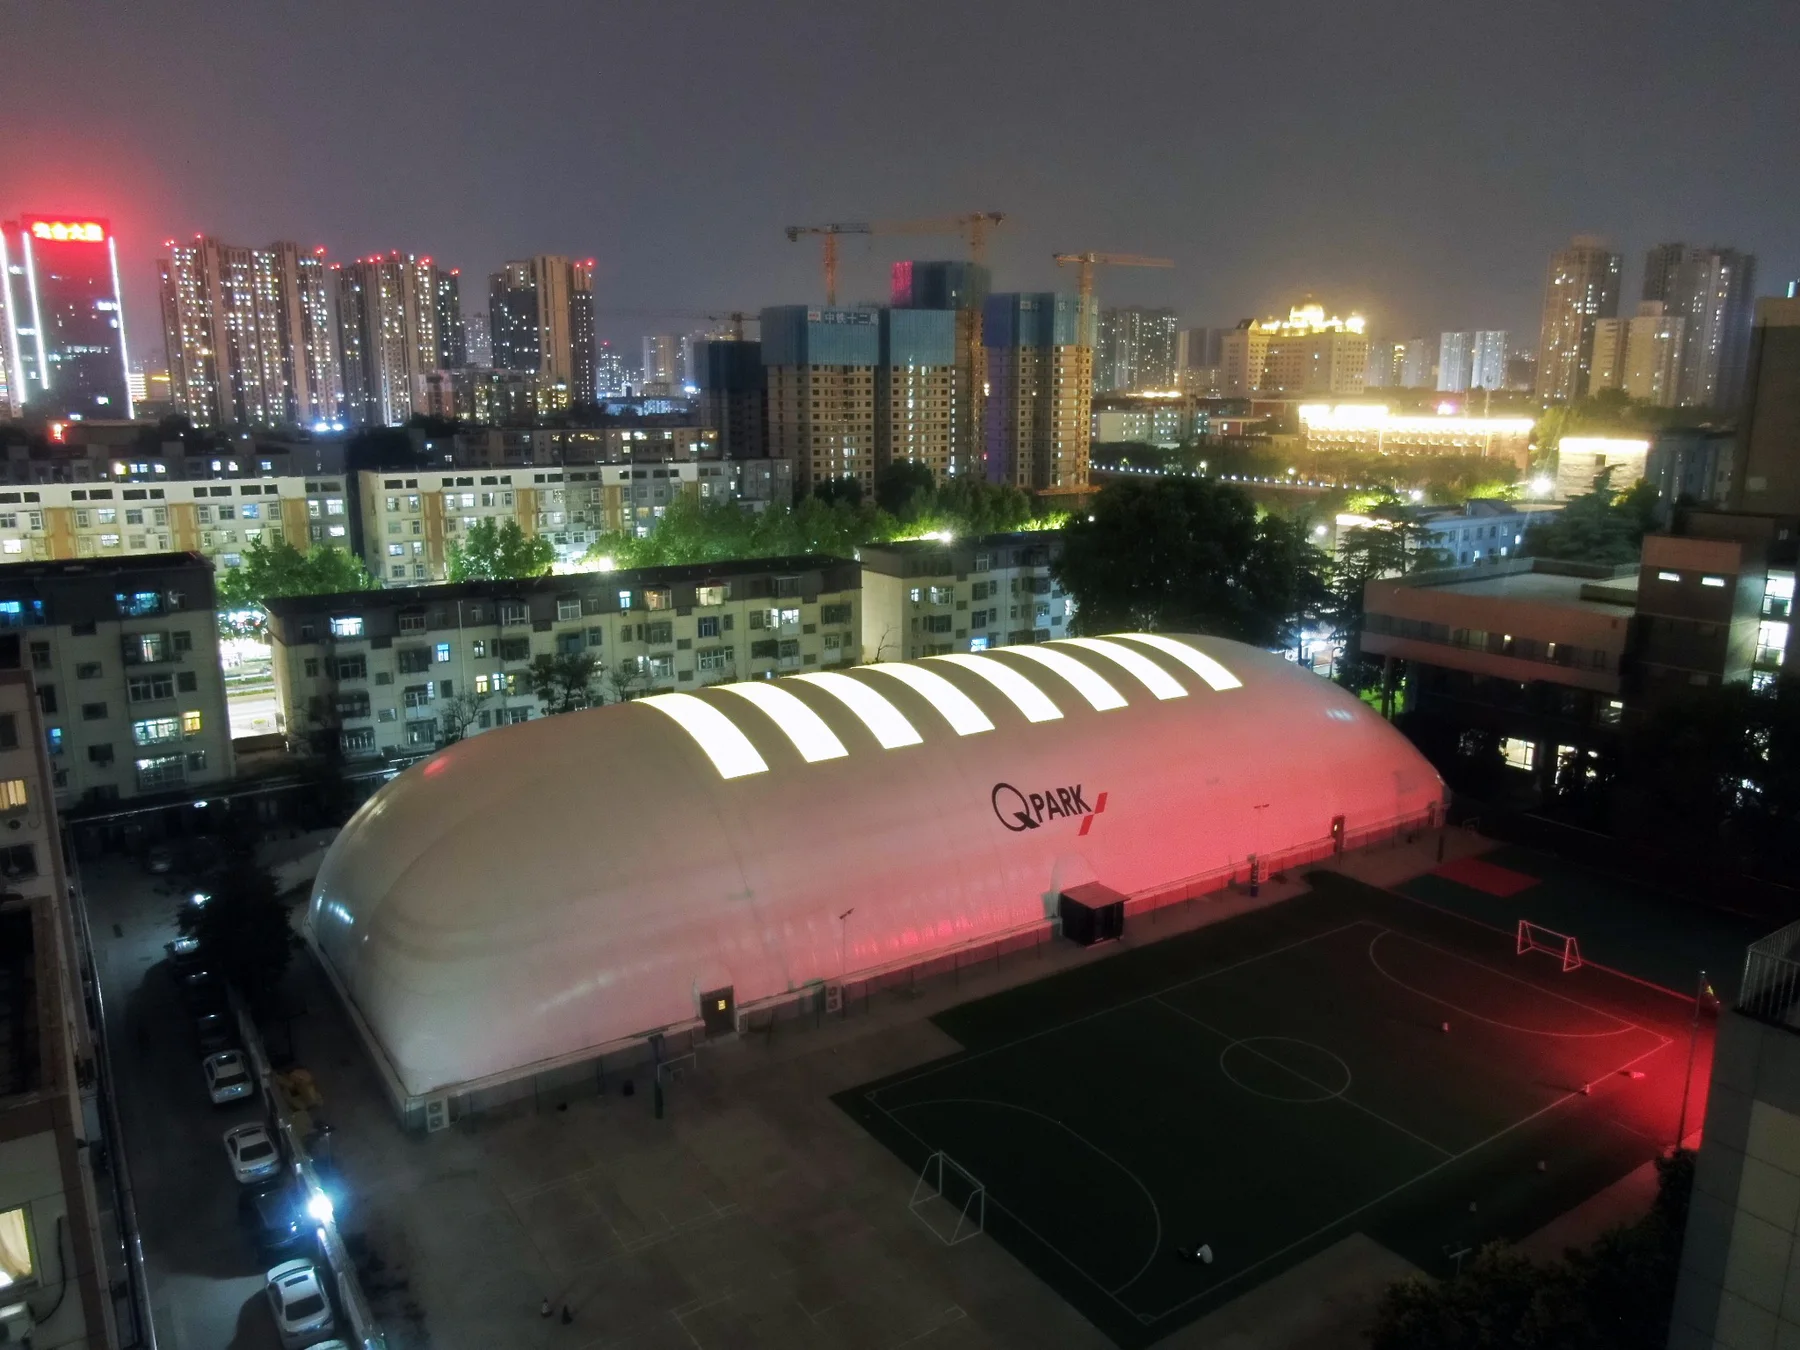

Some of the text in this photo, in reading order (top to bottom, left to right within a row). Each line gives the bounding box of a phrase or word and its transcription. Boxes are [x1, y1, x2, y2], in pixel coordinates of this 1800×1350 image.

[824, 311, 879, 325] 中铁十二局
